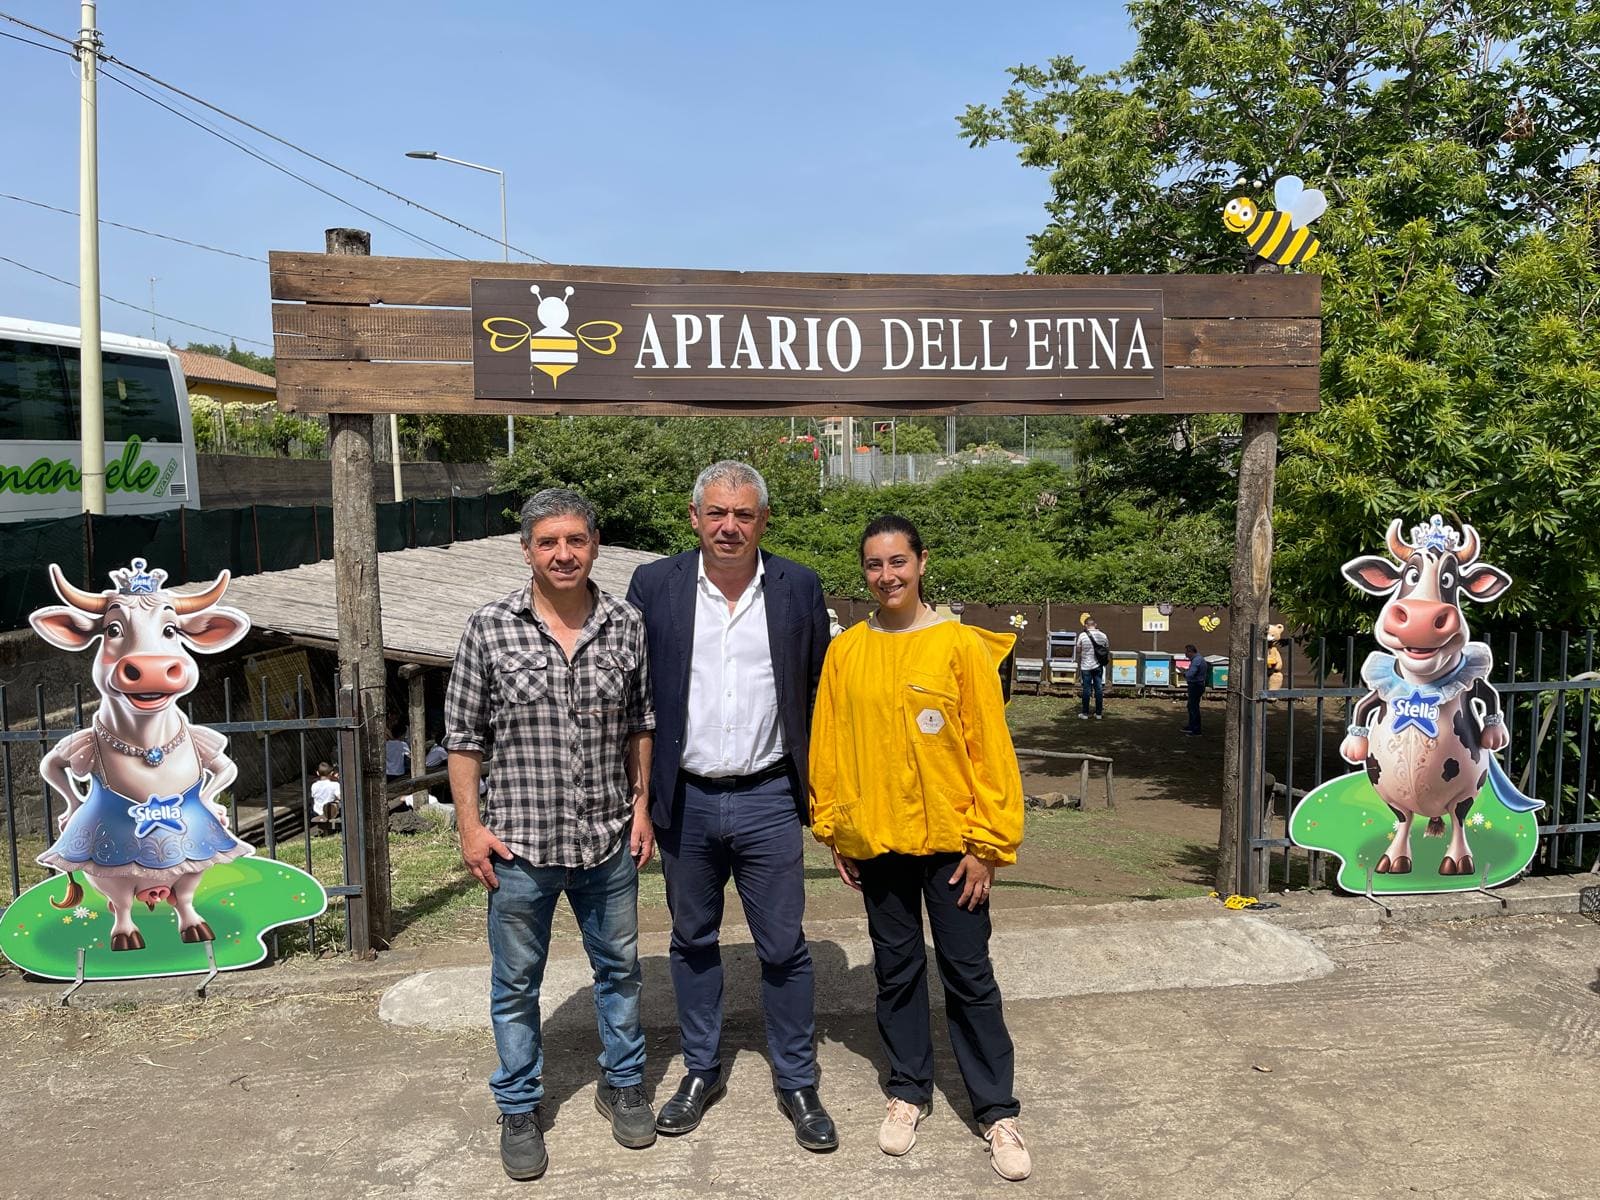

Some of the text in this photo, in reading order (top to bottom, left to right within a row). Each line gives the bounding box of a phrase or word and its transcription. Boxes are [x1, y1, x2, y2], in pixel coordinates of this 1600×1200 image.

[634, 313, 1155, 373] APIARIO DELL'ETNA
[0, 436, 159, 492] manele
[1396, 699, 1438, 720] Stella
[135, 804, 181, 822] Stella
